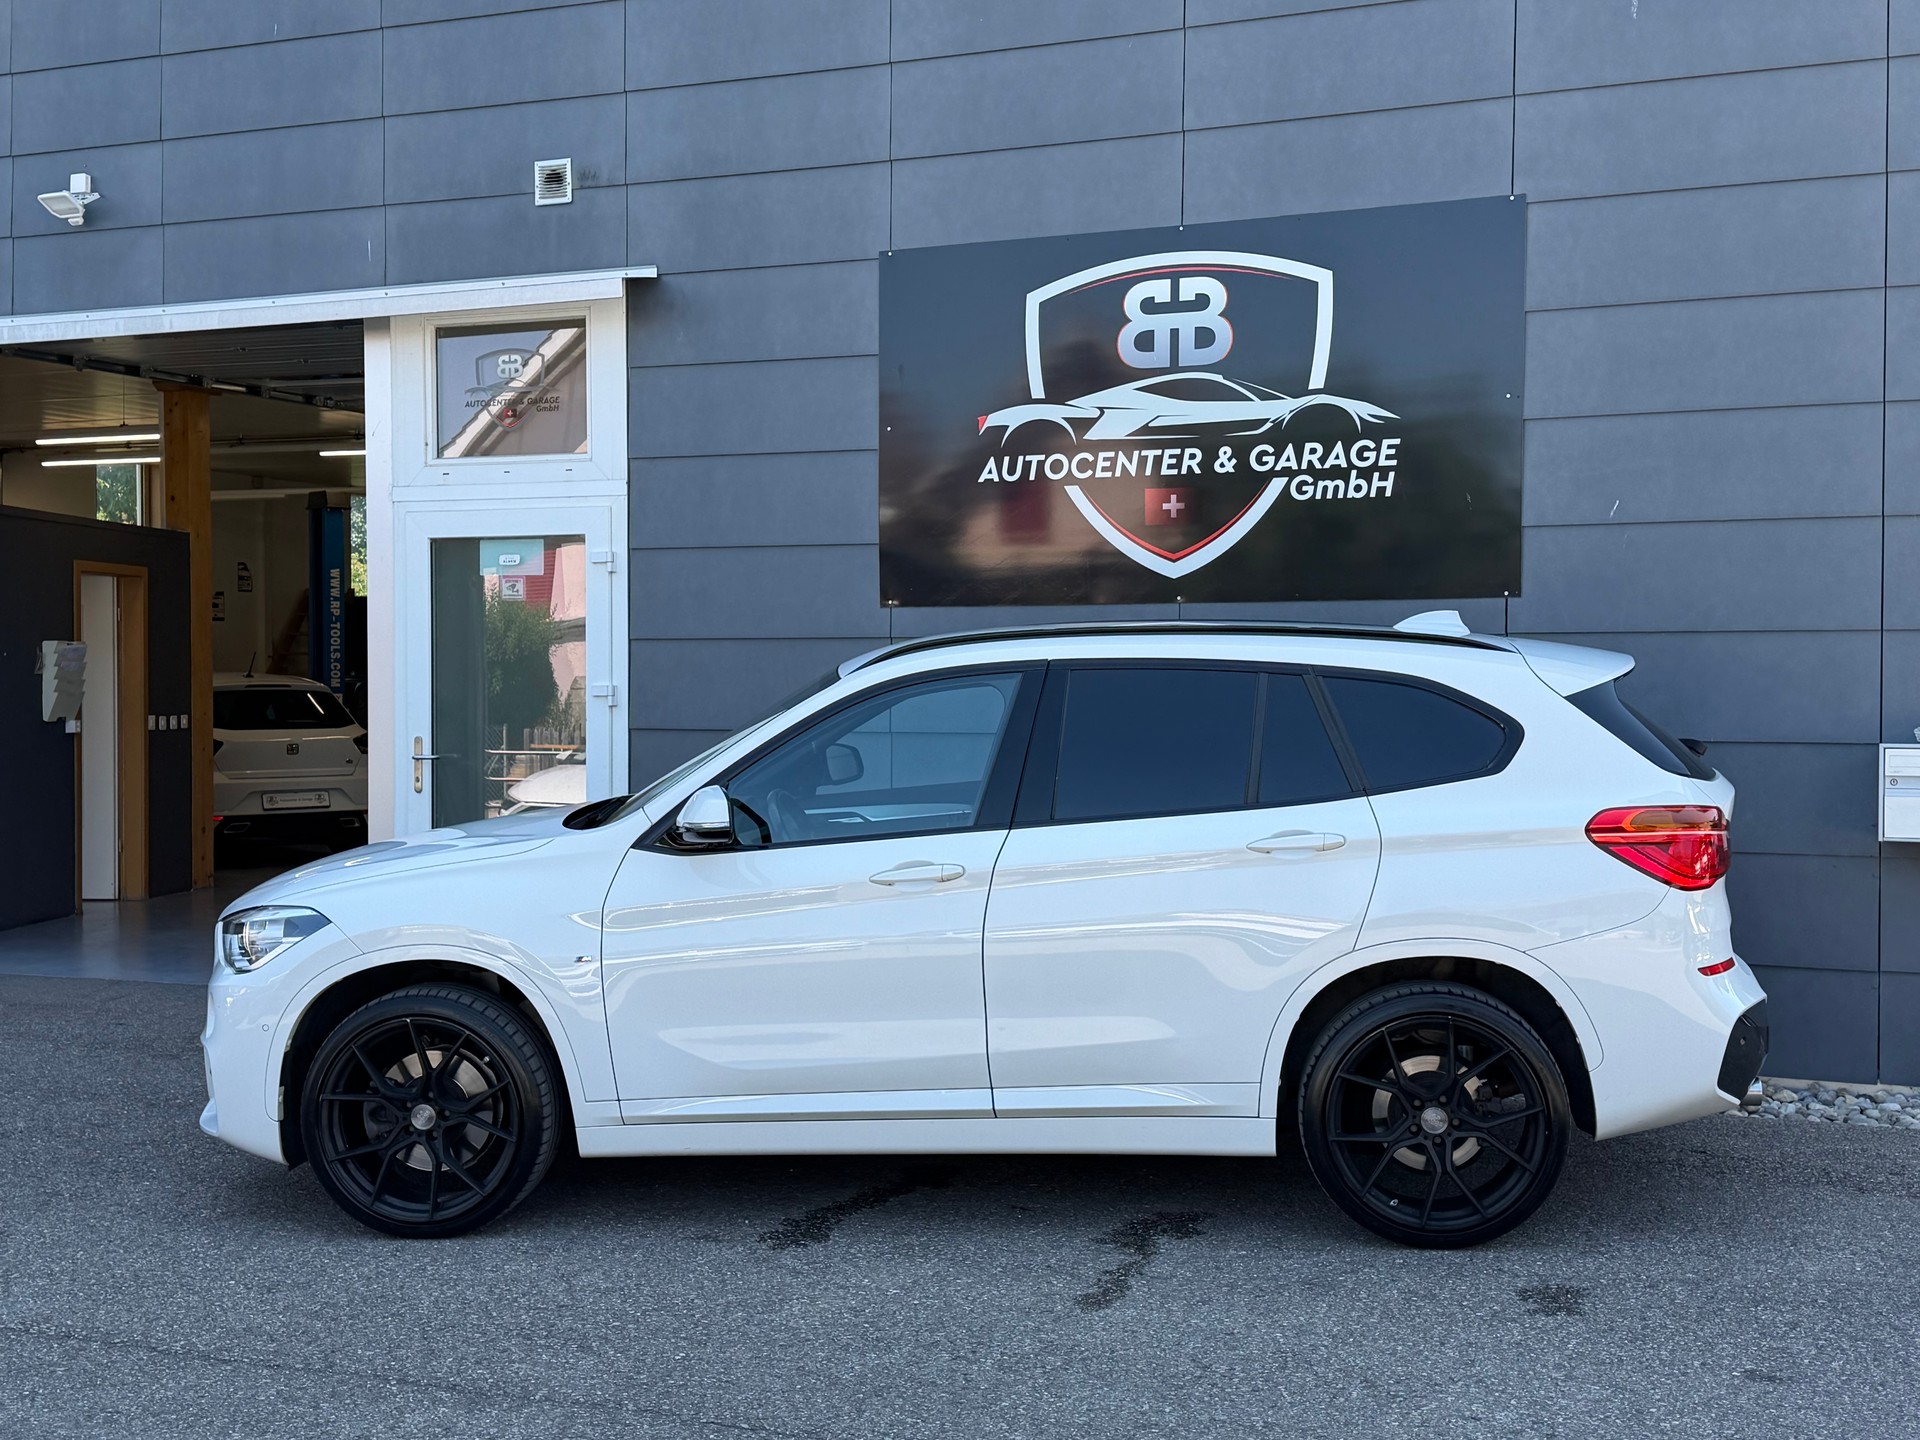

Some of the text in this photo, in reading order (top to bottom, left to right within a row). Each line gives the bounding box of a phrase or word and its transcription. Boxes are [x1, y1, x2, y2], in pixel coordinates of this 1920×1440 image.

[527, 396, 560, 405] GARAGE
[978, 439, 1400, 483] AUTOCENTER & GARAGE
[1290, 471, 1395, 501] GmbH
[330, 568, 341, 687] WWW.RP-TOOLS.COM
